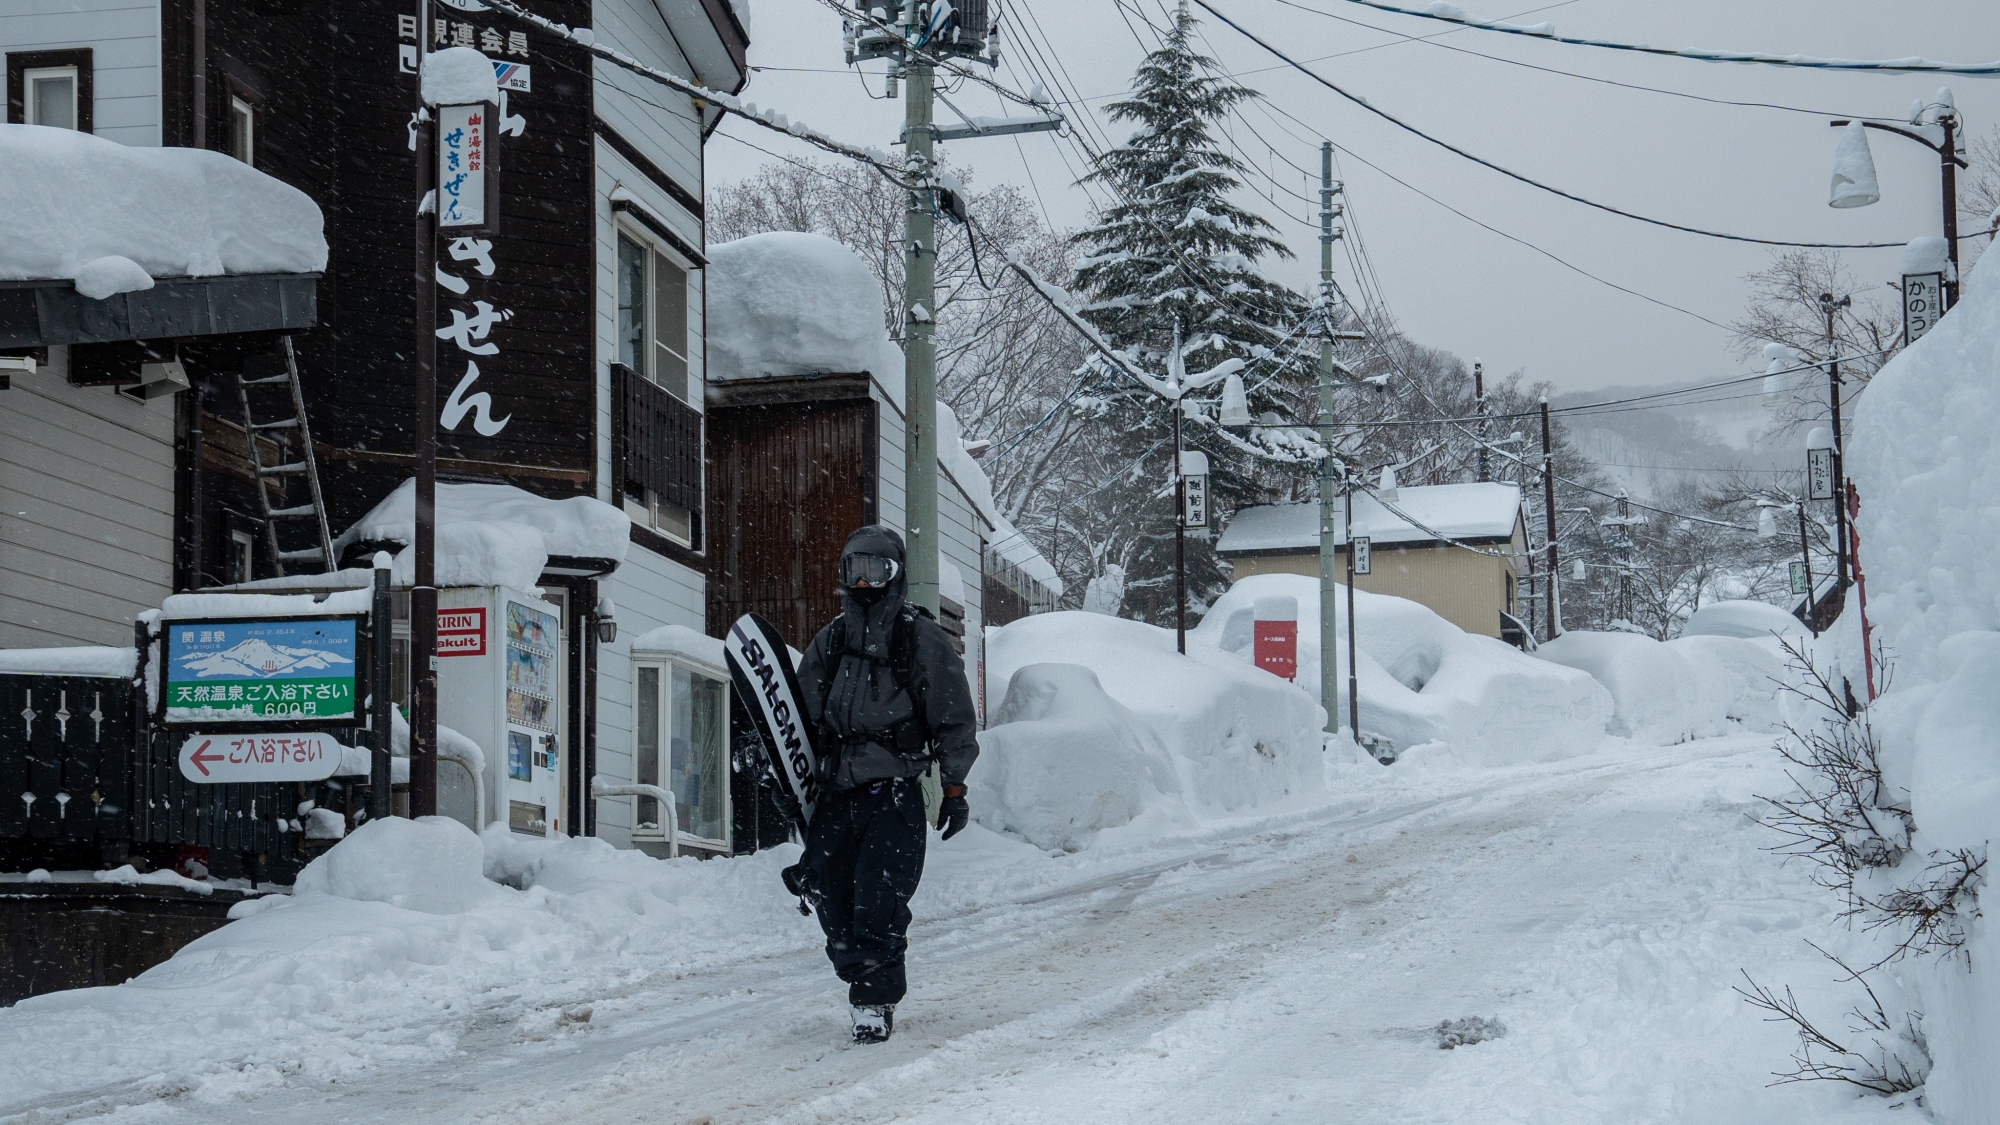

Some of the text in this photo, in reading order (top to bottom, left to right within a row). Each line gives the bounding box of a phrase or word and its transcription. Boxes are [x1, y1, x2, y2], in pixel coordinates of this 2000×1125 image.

[510, 78, 527, 89] 協定
[468, 112, 482, 171] 山の湯旅館
[443, 127, 468, 221] せきぜん
[436, 236, 515, 437] きぜん
[1811, 454, 1826, 494] 小松屋
[438, 637, 478, 648] akult
[177, 683, 348, 702] 天然温泉ご入浴下さい
[264, 702, 317, 717] 600円
[740, 638, 818, 806] SALOMON
[229, 738, 323, 764] ご入浴下さい
